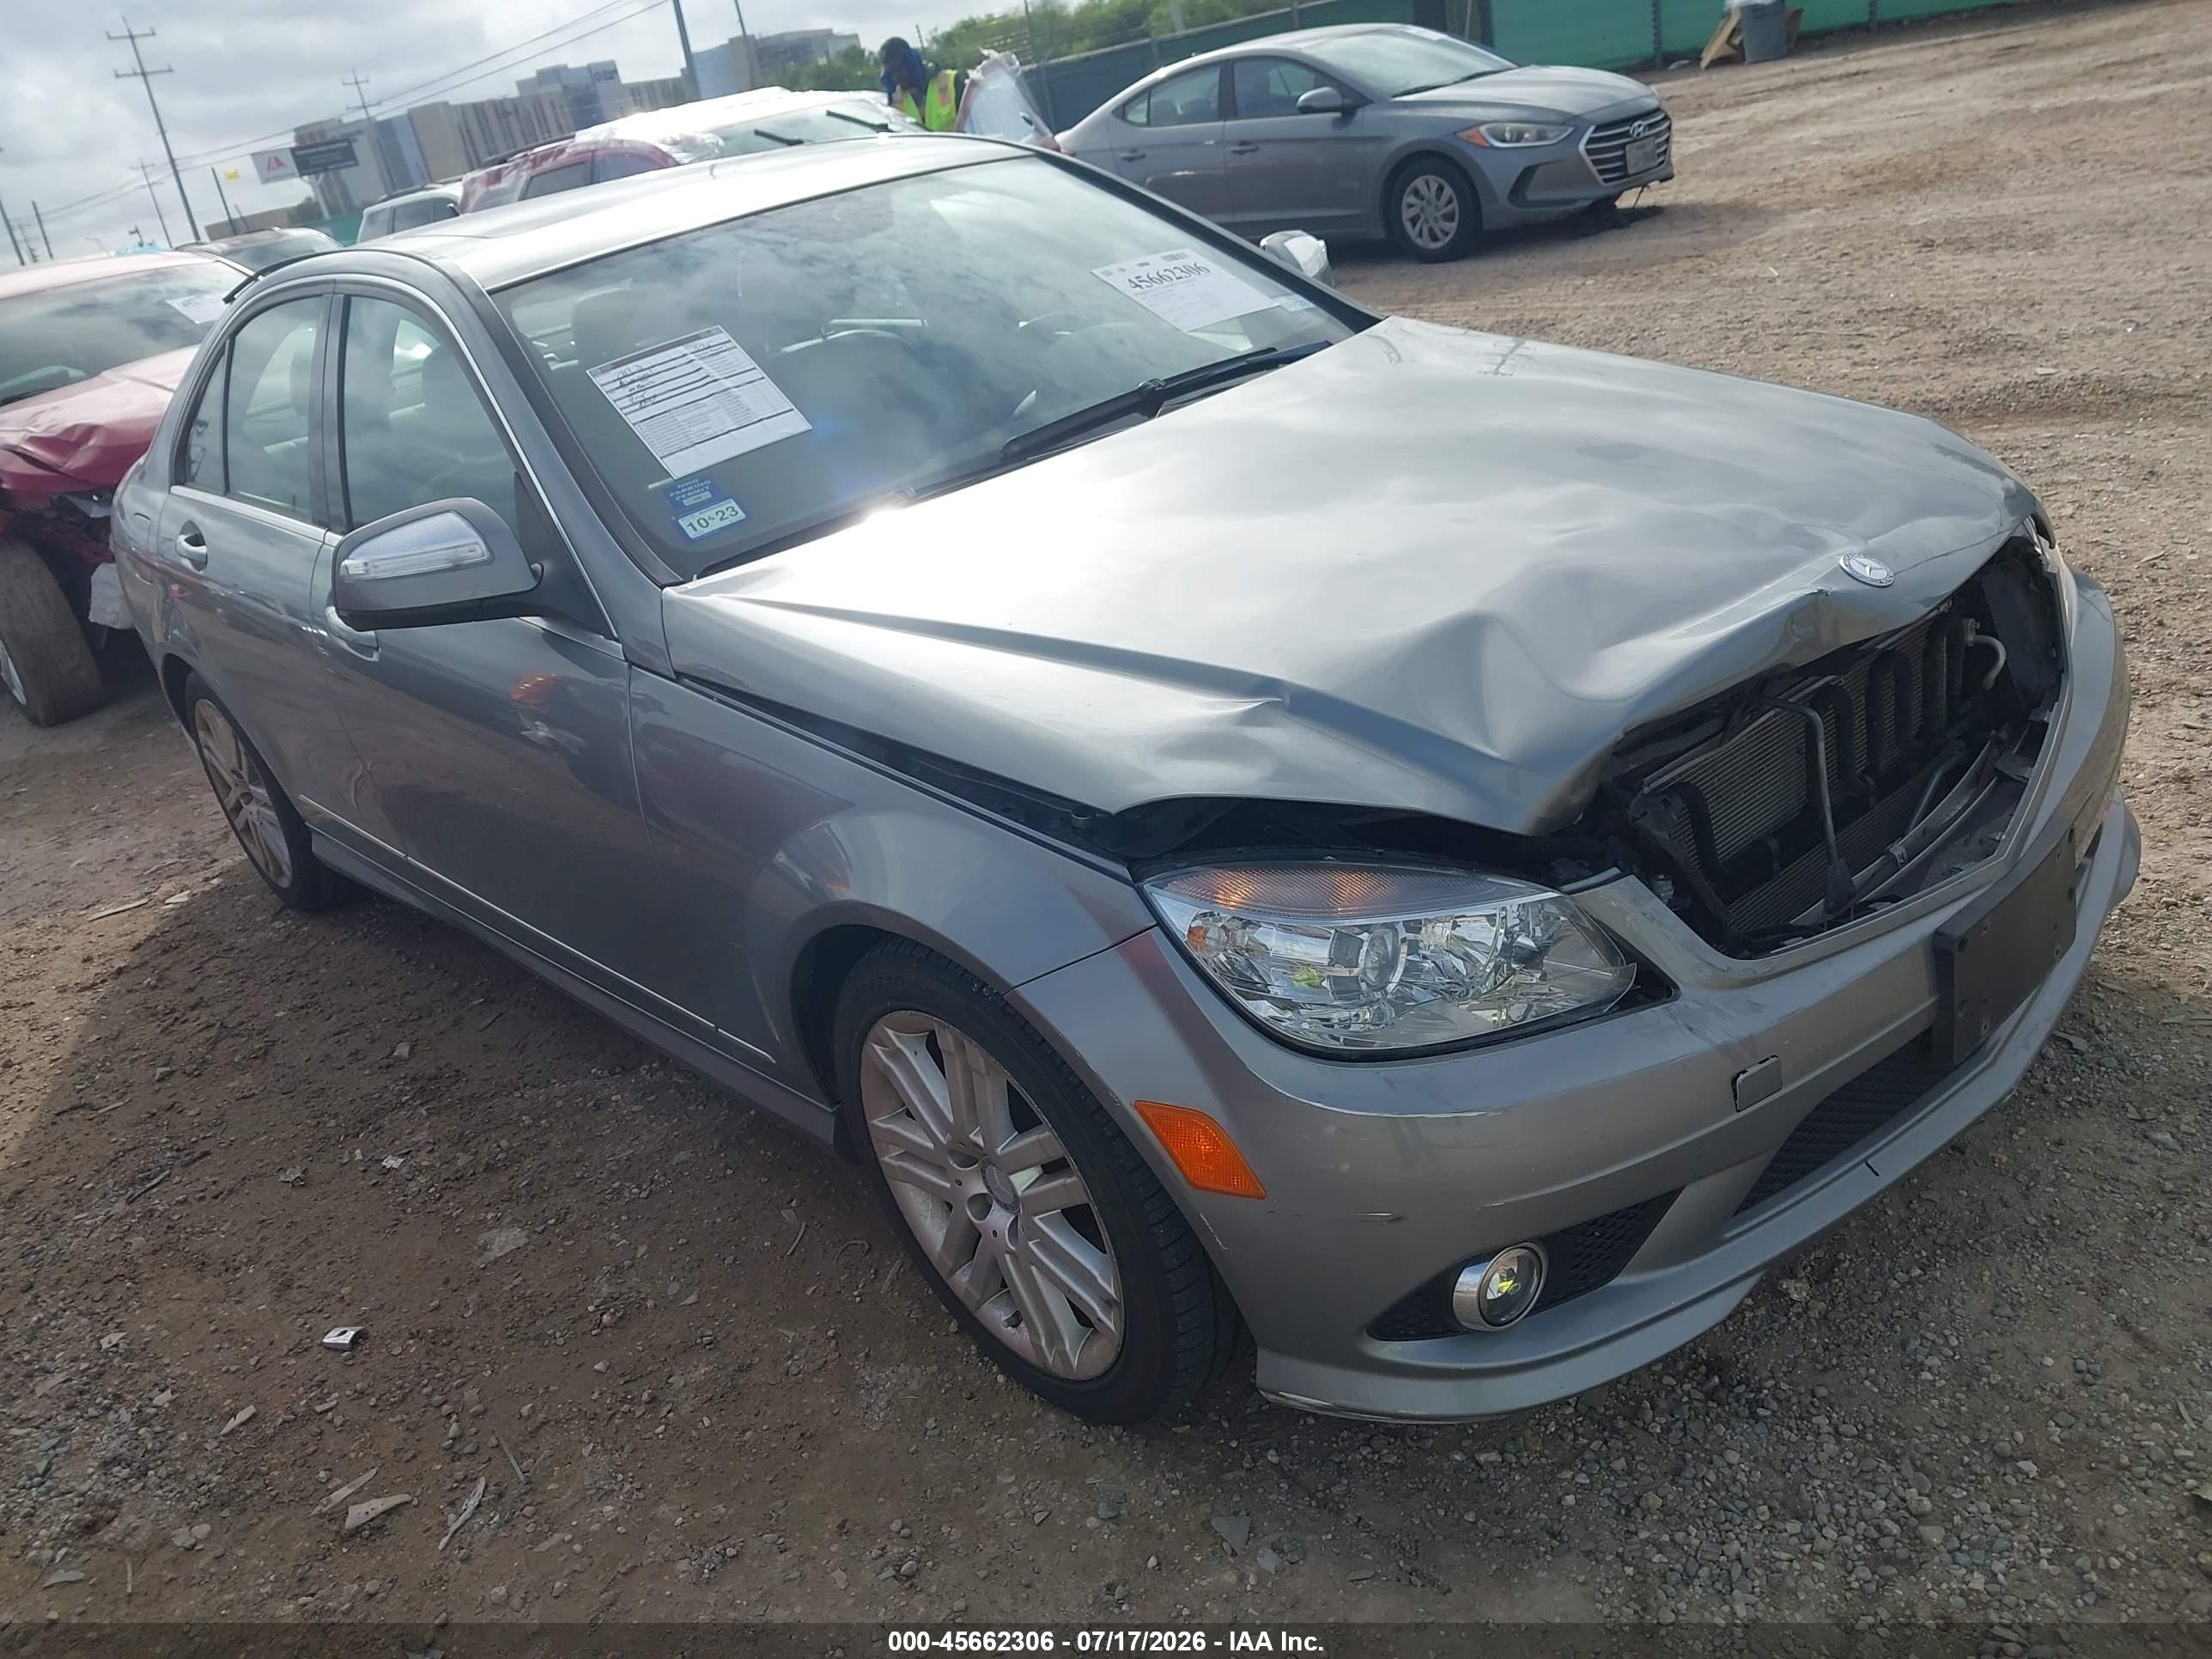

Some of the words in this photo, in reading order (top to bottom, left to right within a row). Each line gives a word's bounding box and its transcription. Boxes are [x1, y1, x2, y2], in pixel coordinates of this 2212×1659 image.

[1127, 261, 1211, 290] 45662306
[670, 480, 711, 497] PARKING
[676, 485, 709, 501] PERMIT
